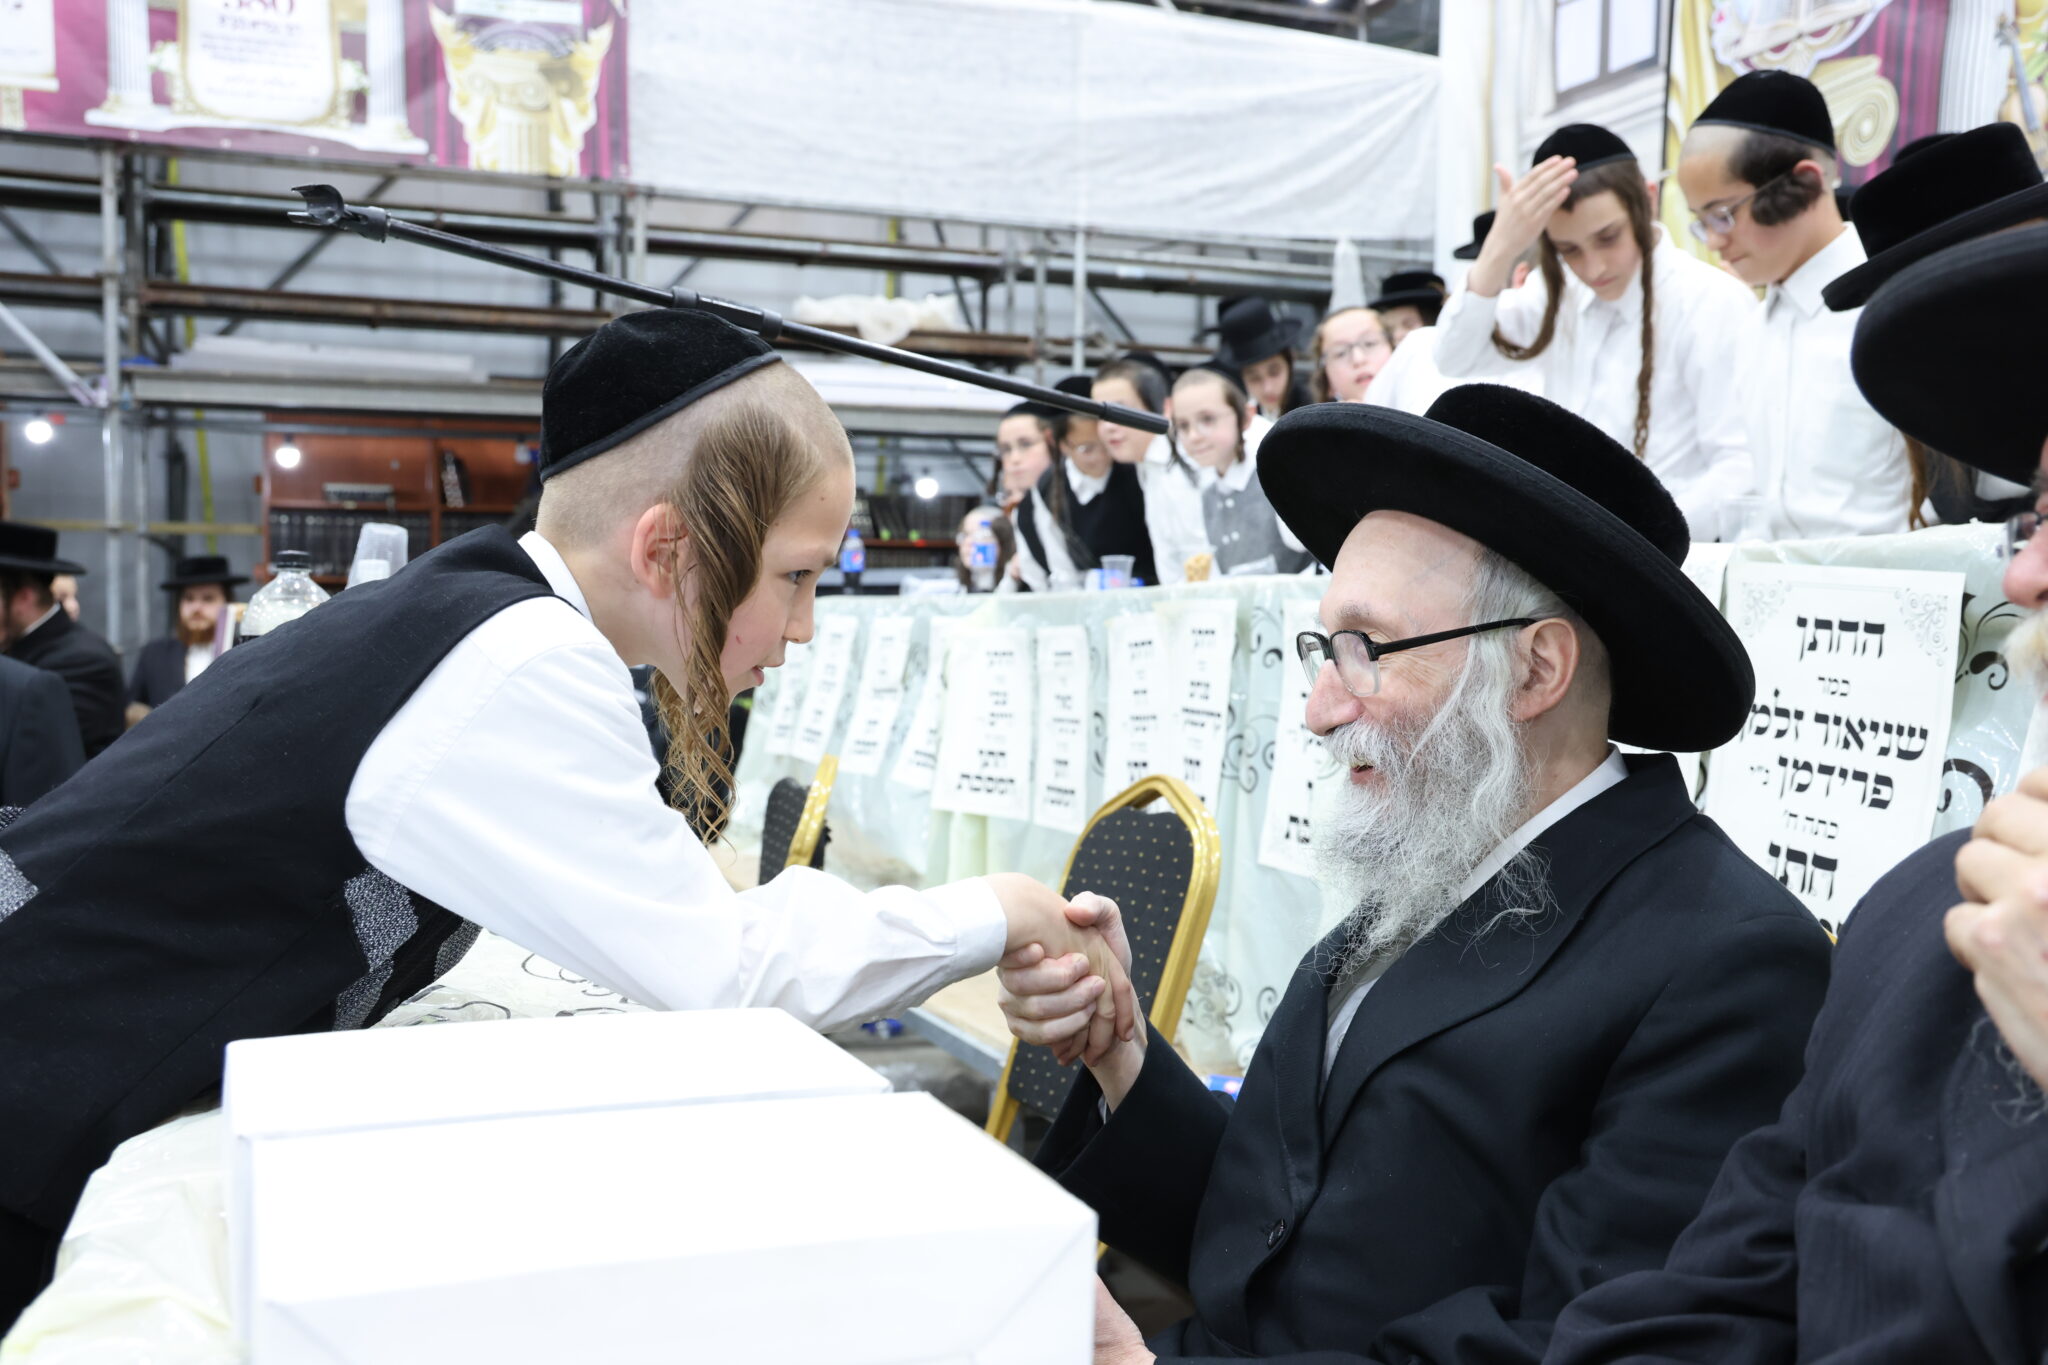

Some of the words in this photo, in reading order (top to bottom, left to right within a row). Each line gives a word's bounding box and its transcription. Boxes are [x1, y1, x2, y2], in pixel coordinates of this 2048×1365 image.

[1797, 616, 1885, 660] החתן
[1814, 712, 1928, 761] שניאור
[1778, 756, 1893, 809] פרידמן
[1769, 842, 1838, 900] חתן
